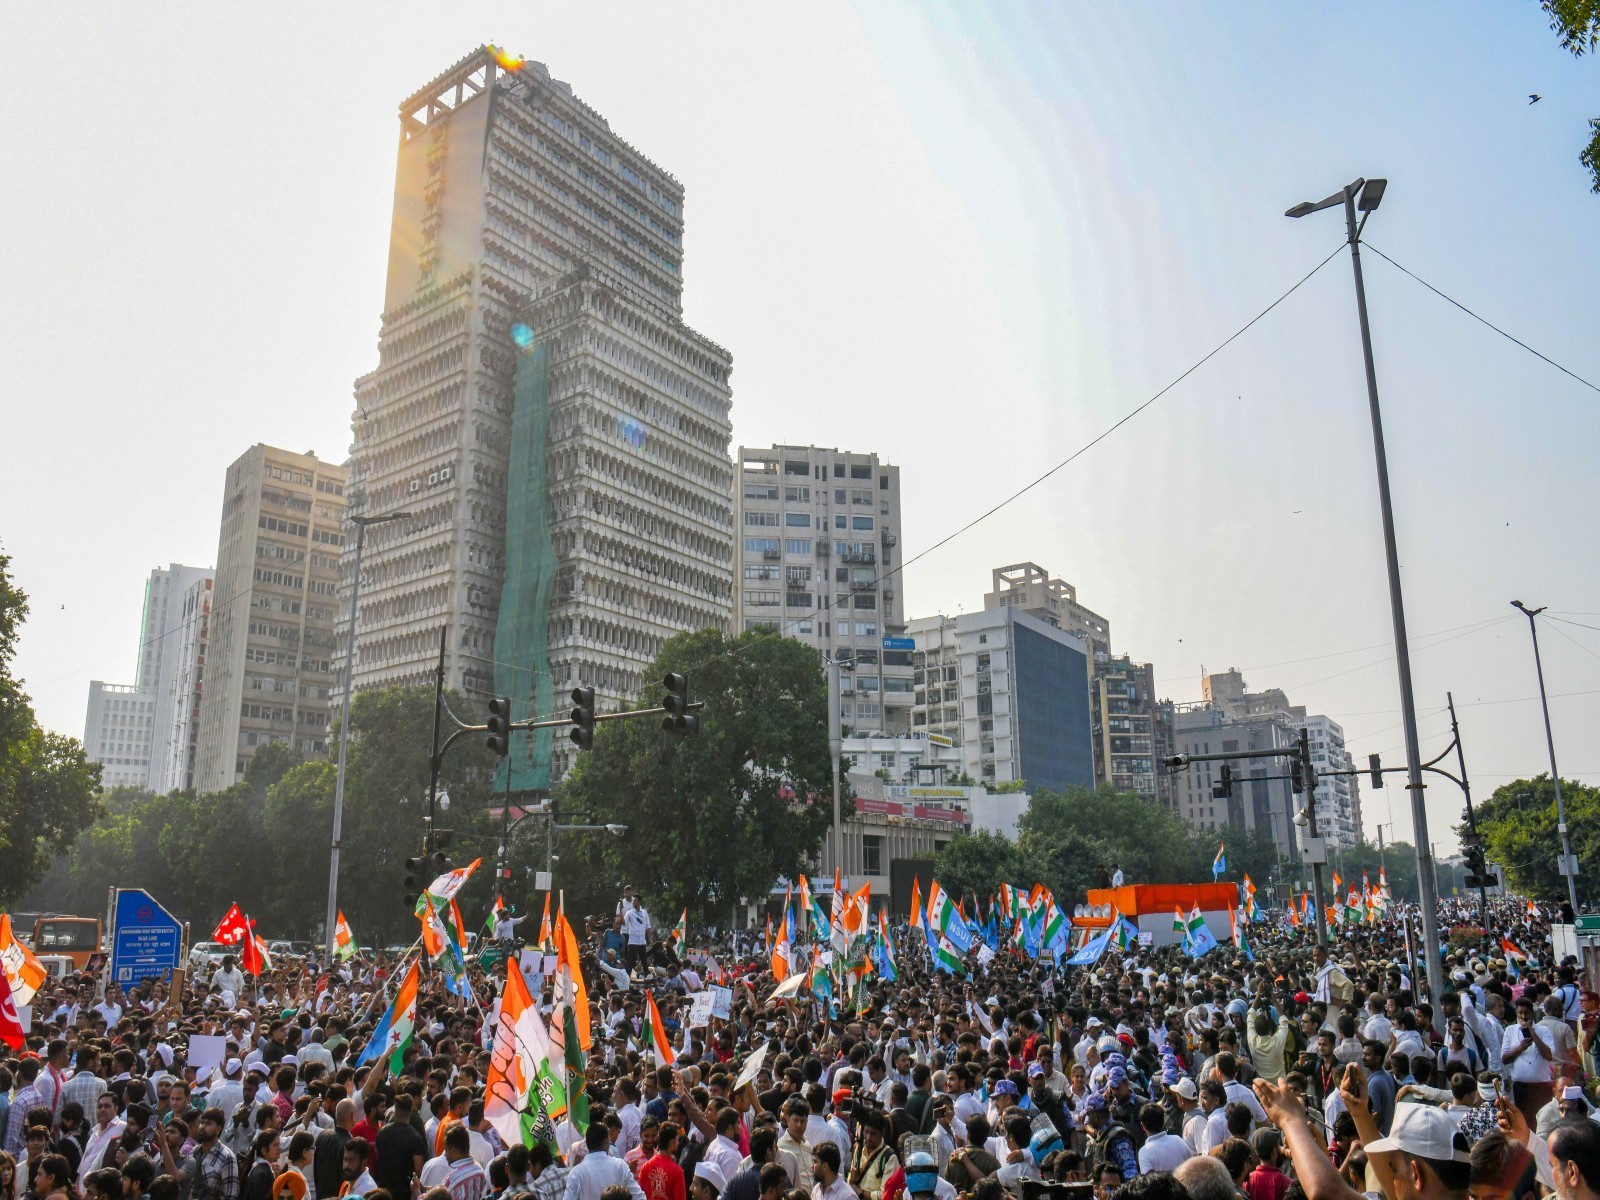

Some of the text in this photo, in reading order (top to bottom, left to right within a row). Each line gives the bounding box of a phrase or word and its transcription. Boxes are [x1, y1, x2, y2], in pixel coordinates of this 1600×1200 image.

[856, 781, 874, 794] HANS
[891, 787, 965, 798] BLS INTERNATIONAL
[950, 921, 969, 943] NSUI
